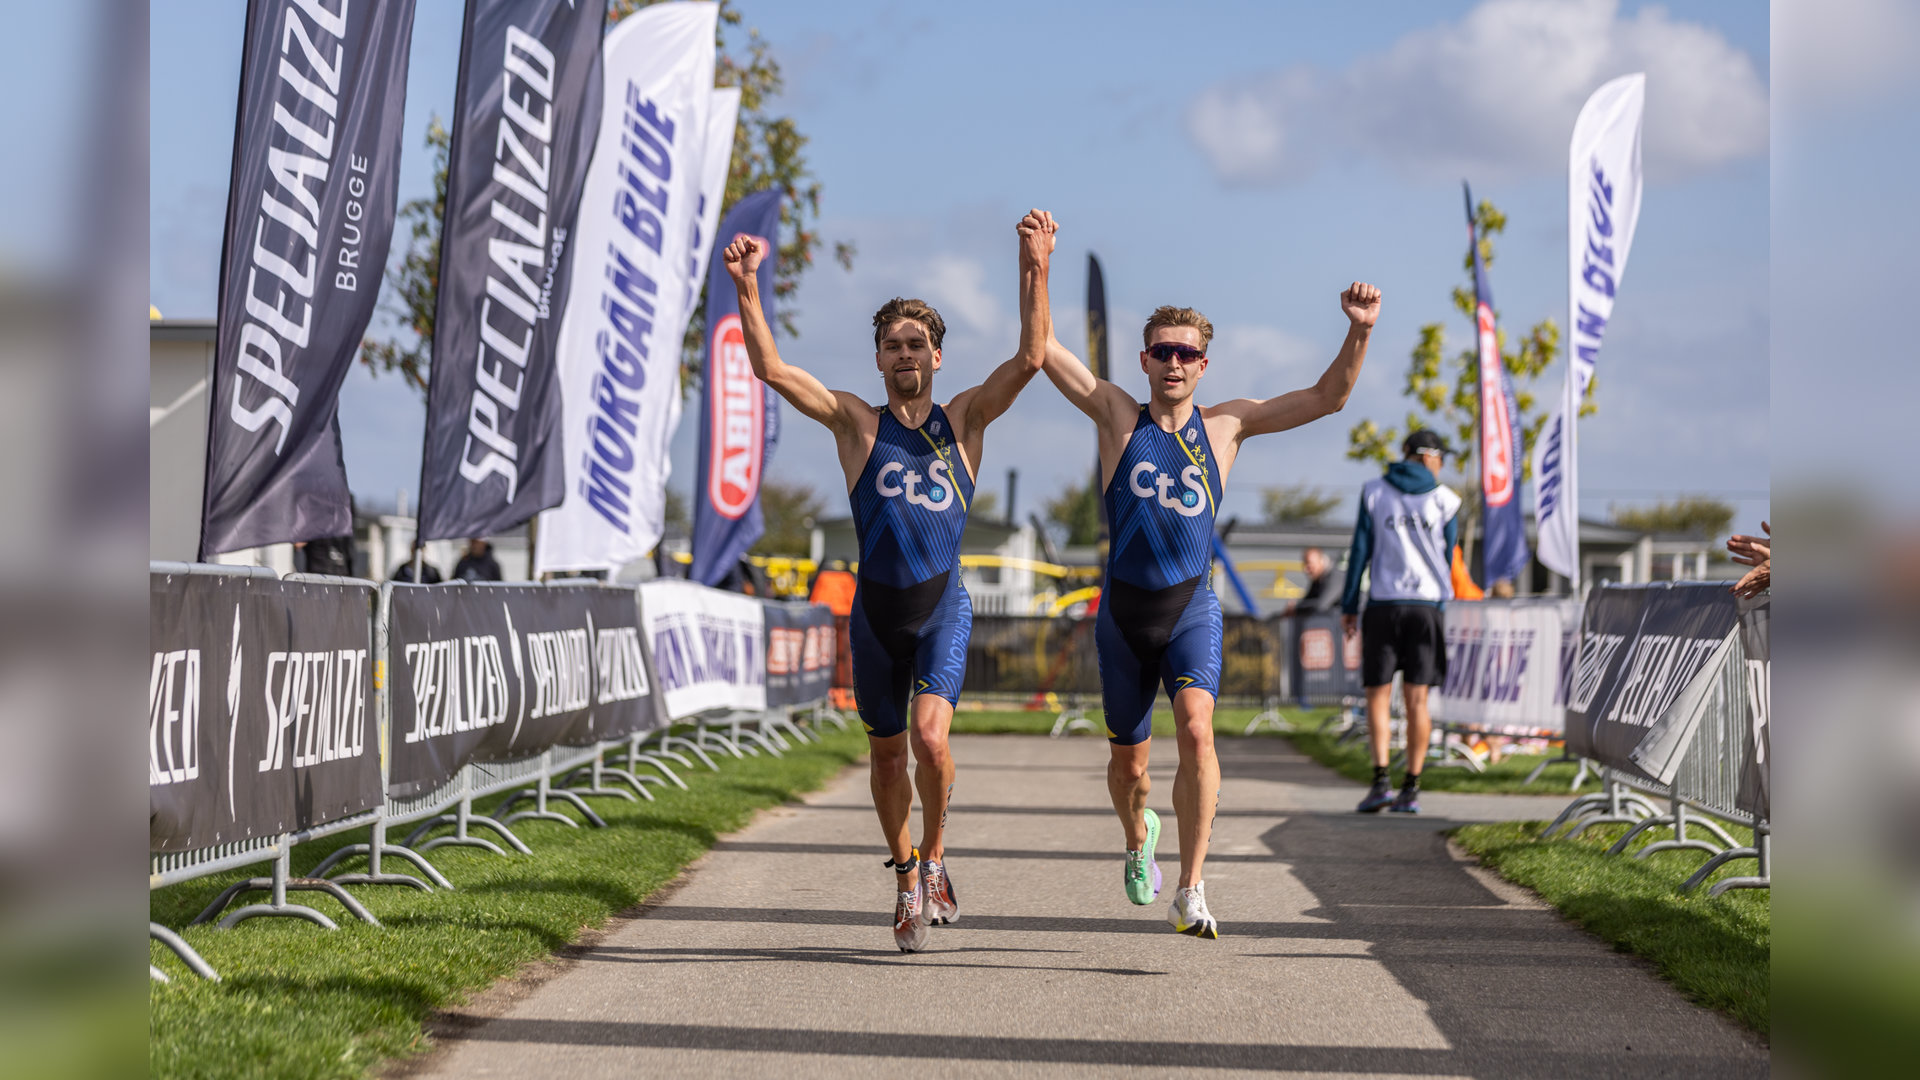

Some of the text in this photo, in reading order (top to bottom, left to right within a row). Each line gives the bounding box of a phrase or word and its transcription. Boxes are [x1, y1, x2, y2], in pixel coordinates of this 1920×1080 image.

[335, 153, 368, 291] BRUGGE
[459, 25, 556, 503] SPECIALIZED
[578, 77, 676, 535] MORGAN BLUE
[723, 341, 753, 493] ABUS
